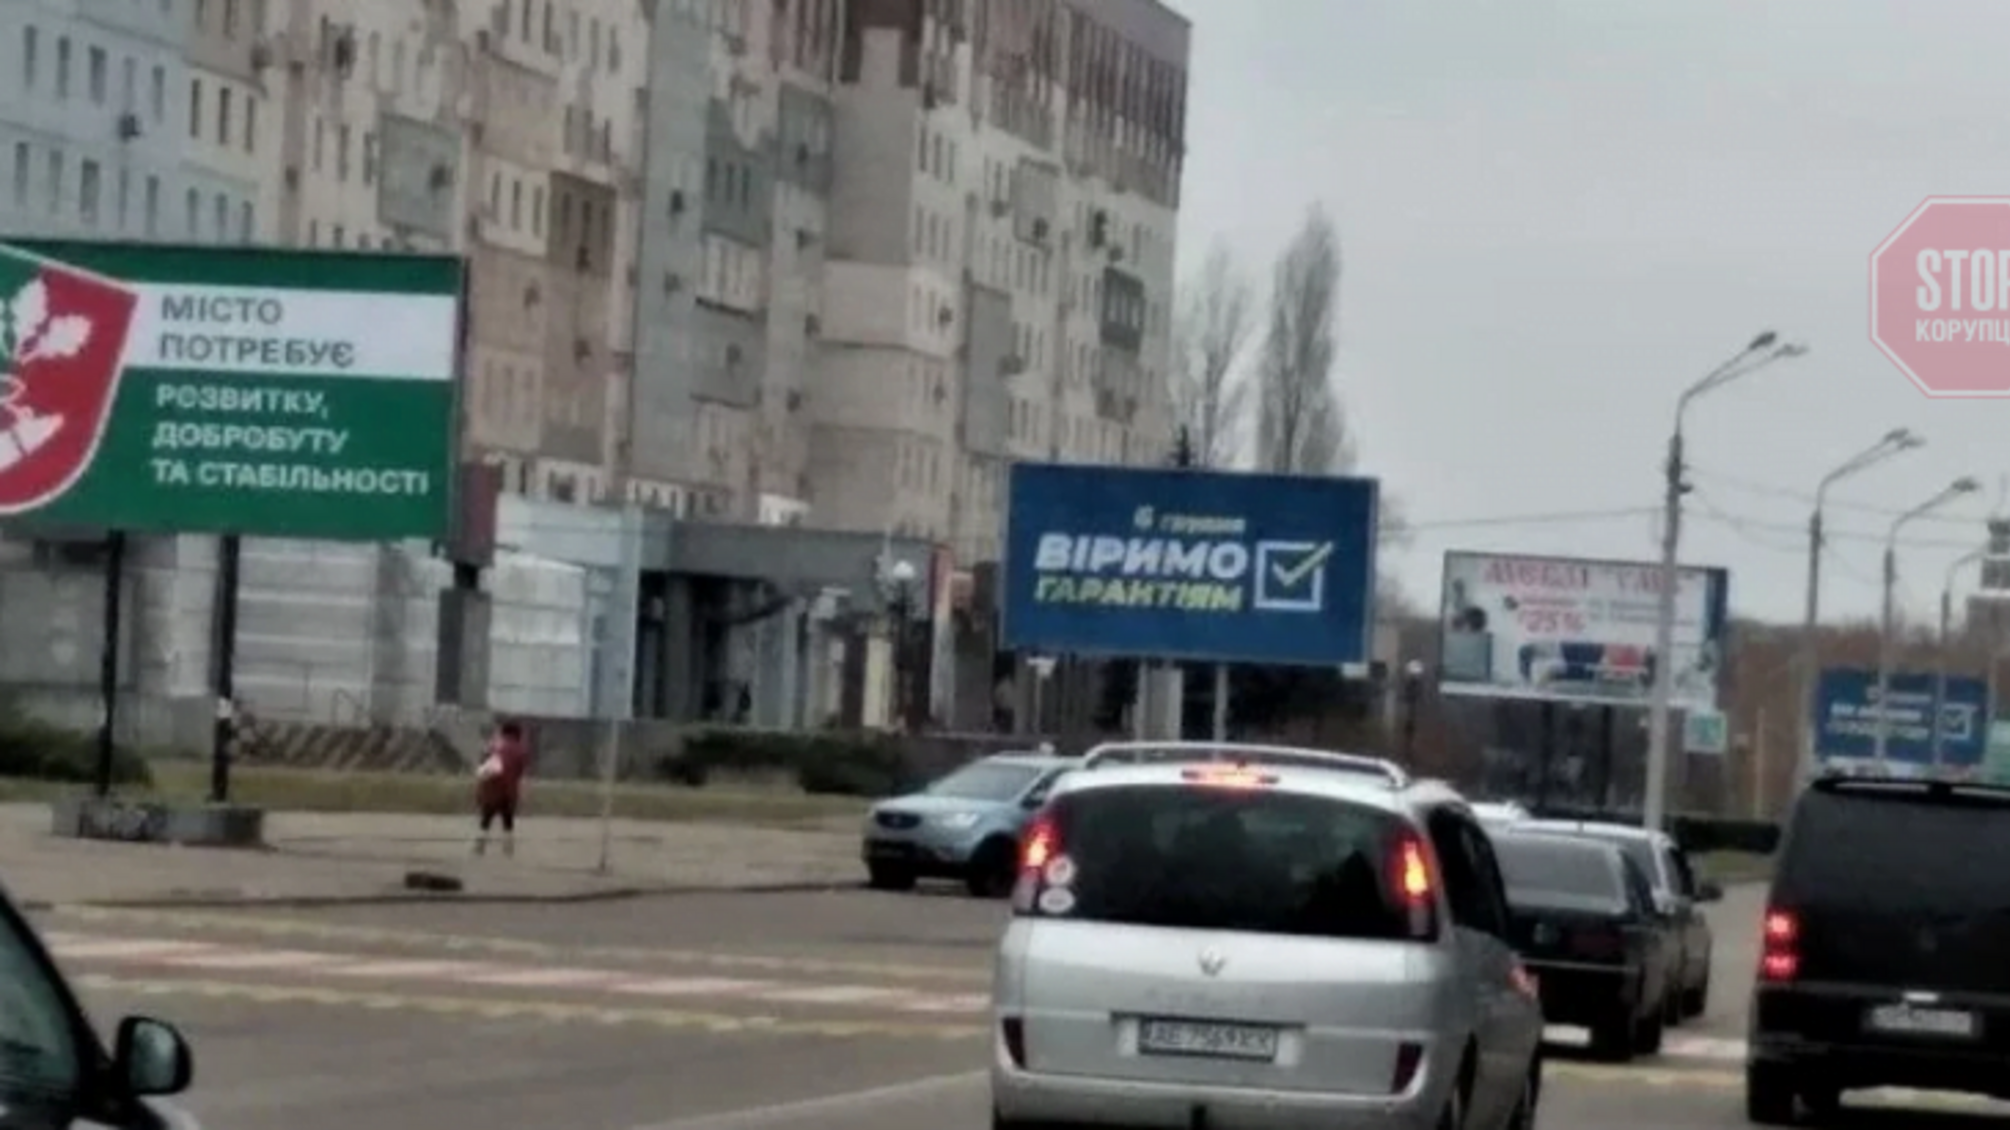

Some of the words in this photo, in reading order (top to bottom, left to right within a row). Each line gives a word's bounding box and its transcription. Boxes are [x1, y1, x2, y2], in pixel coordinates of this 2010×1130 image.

[160, 294, 283, 325] МІСТО
[158, 333, 355, 368] ПОТРЕБУЄ
[155, 383, 329, 418] РОЗВИТКУ,
[152, 421, 349, 453] ДОБРОБУТУ
[151, 458, 189, 484] ТА
[197, 460, 430, 494] СТАБІЛЬНОСТІ
[1034, 533, 1249, 580] ВІРИМО
[1034, 576, 1243, 612] ГАРАНТІЯМ
